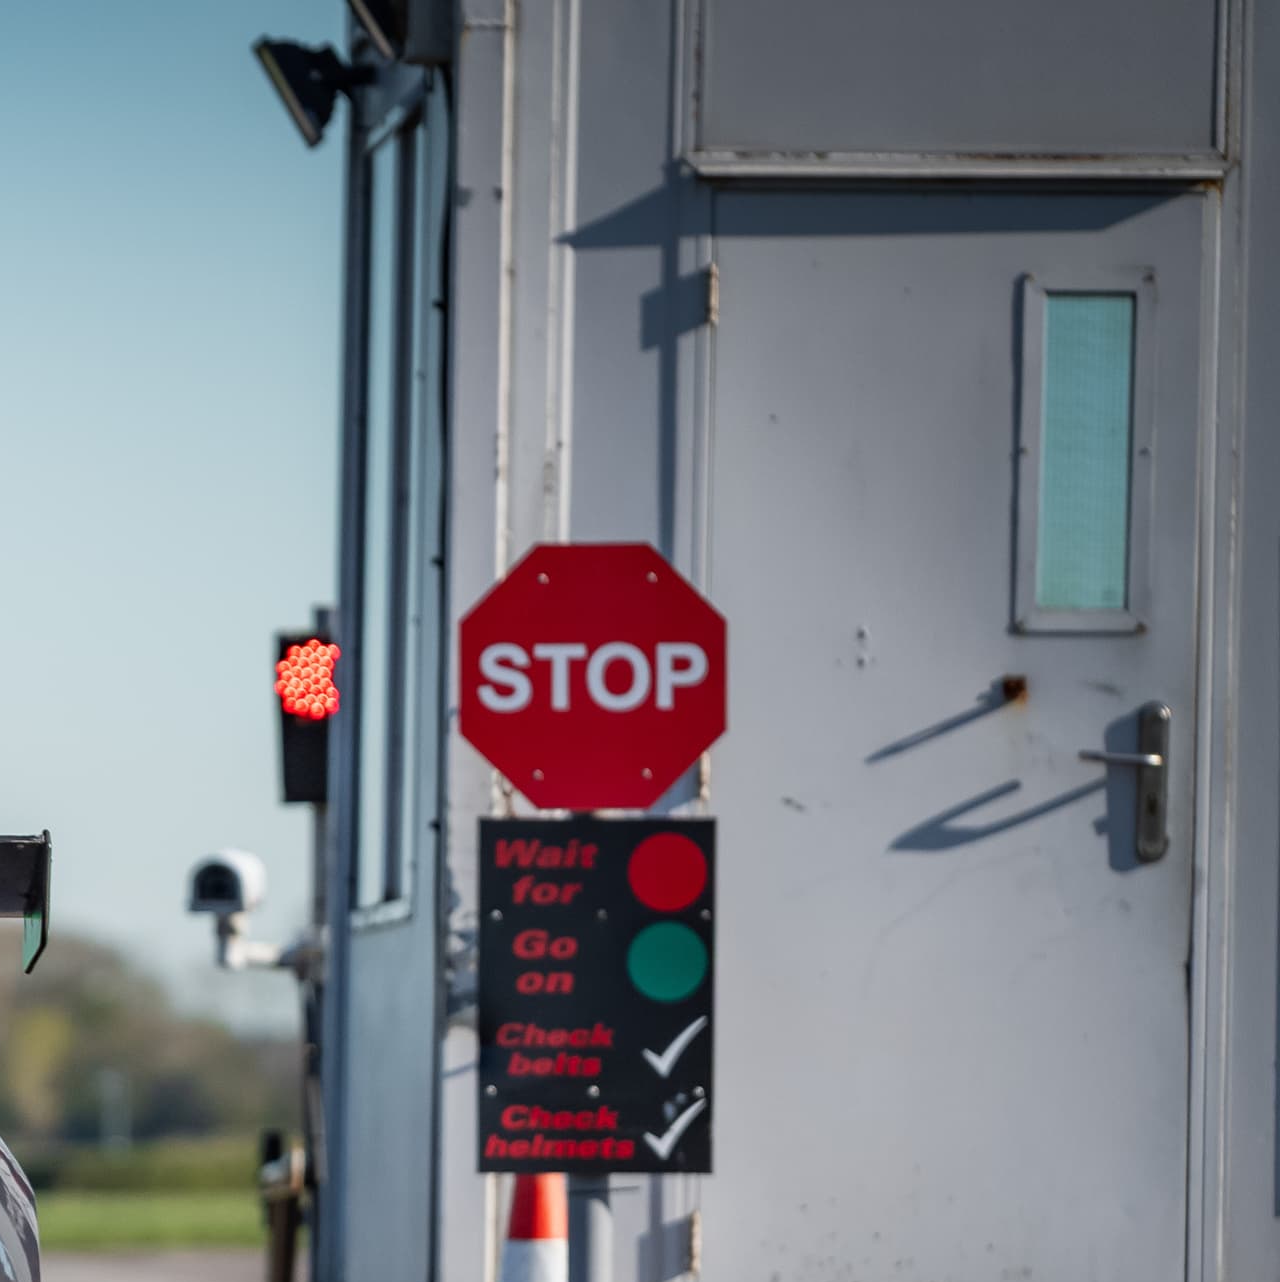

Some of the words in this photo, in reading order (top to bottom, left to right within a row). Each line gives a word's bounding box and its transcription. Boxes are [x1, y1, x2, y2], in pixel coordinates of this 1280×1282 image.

[476, 642, 709, 713] STOP
[494, 838, 600, 869] Wait
[512, 874, 582, 906] for
[512, 928, 579, 961] Go
[515, 970, 576, 995] on
[496, 1022, 614, 1047] Check
[507, 1052, 603, 1078] belts
[500, 1104, 619, 1131] Check
[484, 1134, 636, 1160] helmets
